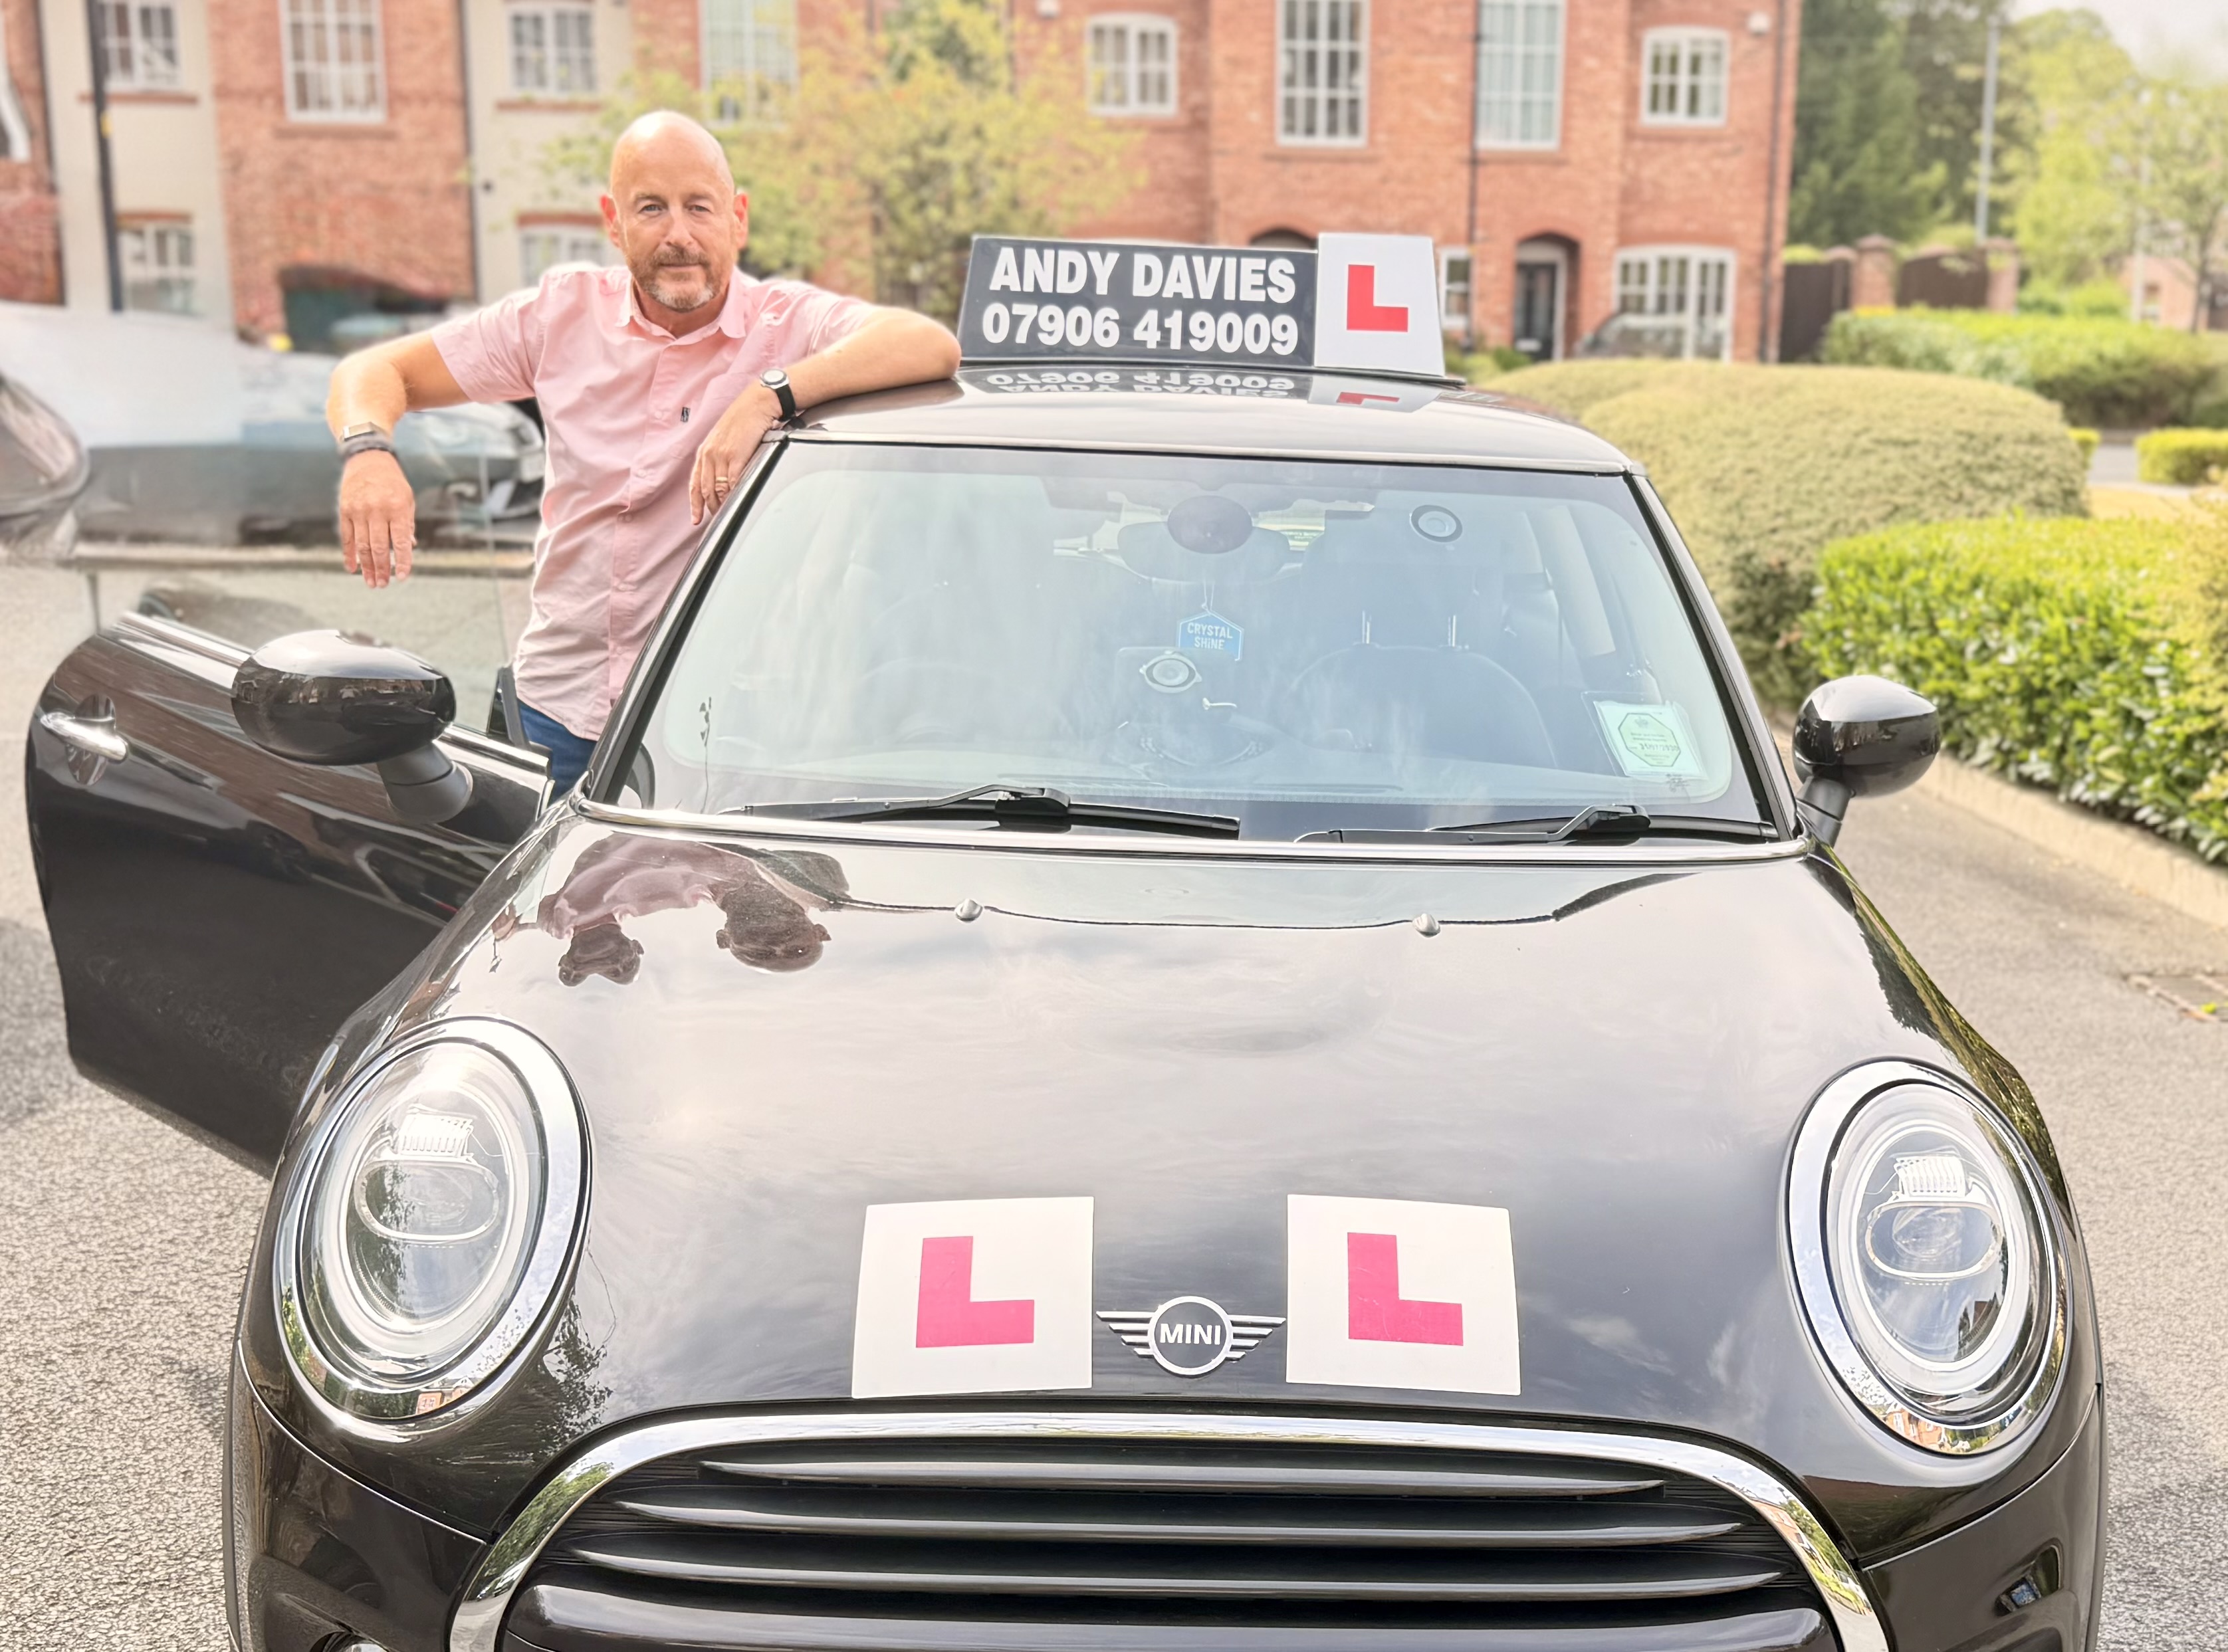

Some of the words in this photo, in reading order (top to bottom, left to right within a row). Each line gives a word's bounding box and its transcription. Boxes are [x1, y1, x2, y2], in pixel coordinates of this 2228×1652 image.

[989, 247, 1120, 295] ANDY
[1132, 253, 1295, 304] DAVIES
[1347, 264, 1408, 332] L
[982, 302, 1120, 348] 07906
[1133, 309, 1298, 356] 419009
[1187, 622, 1233, 639] CRYSTAL
[915, 1235, 1035, 1348] L
[1347, 1232, 1464, 1346] L
[1160, 1323, 1220, 1345] MINI
